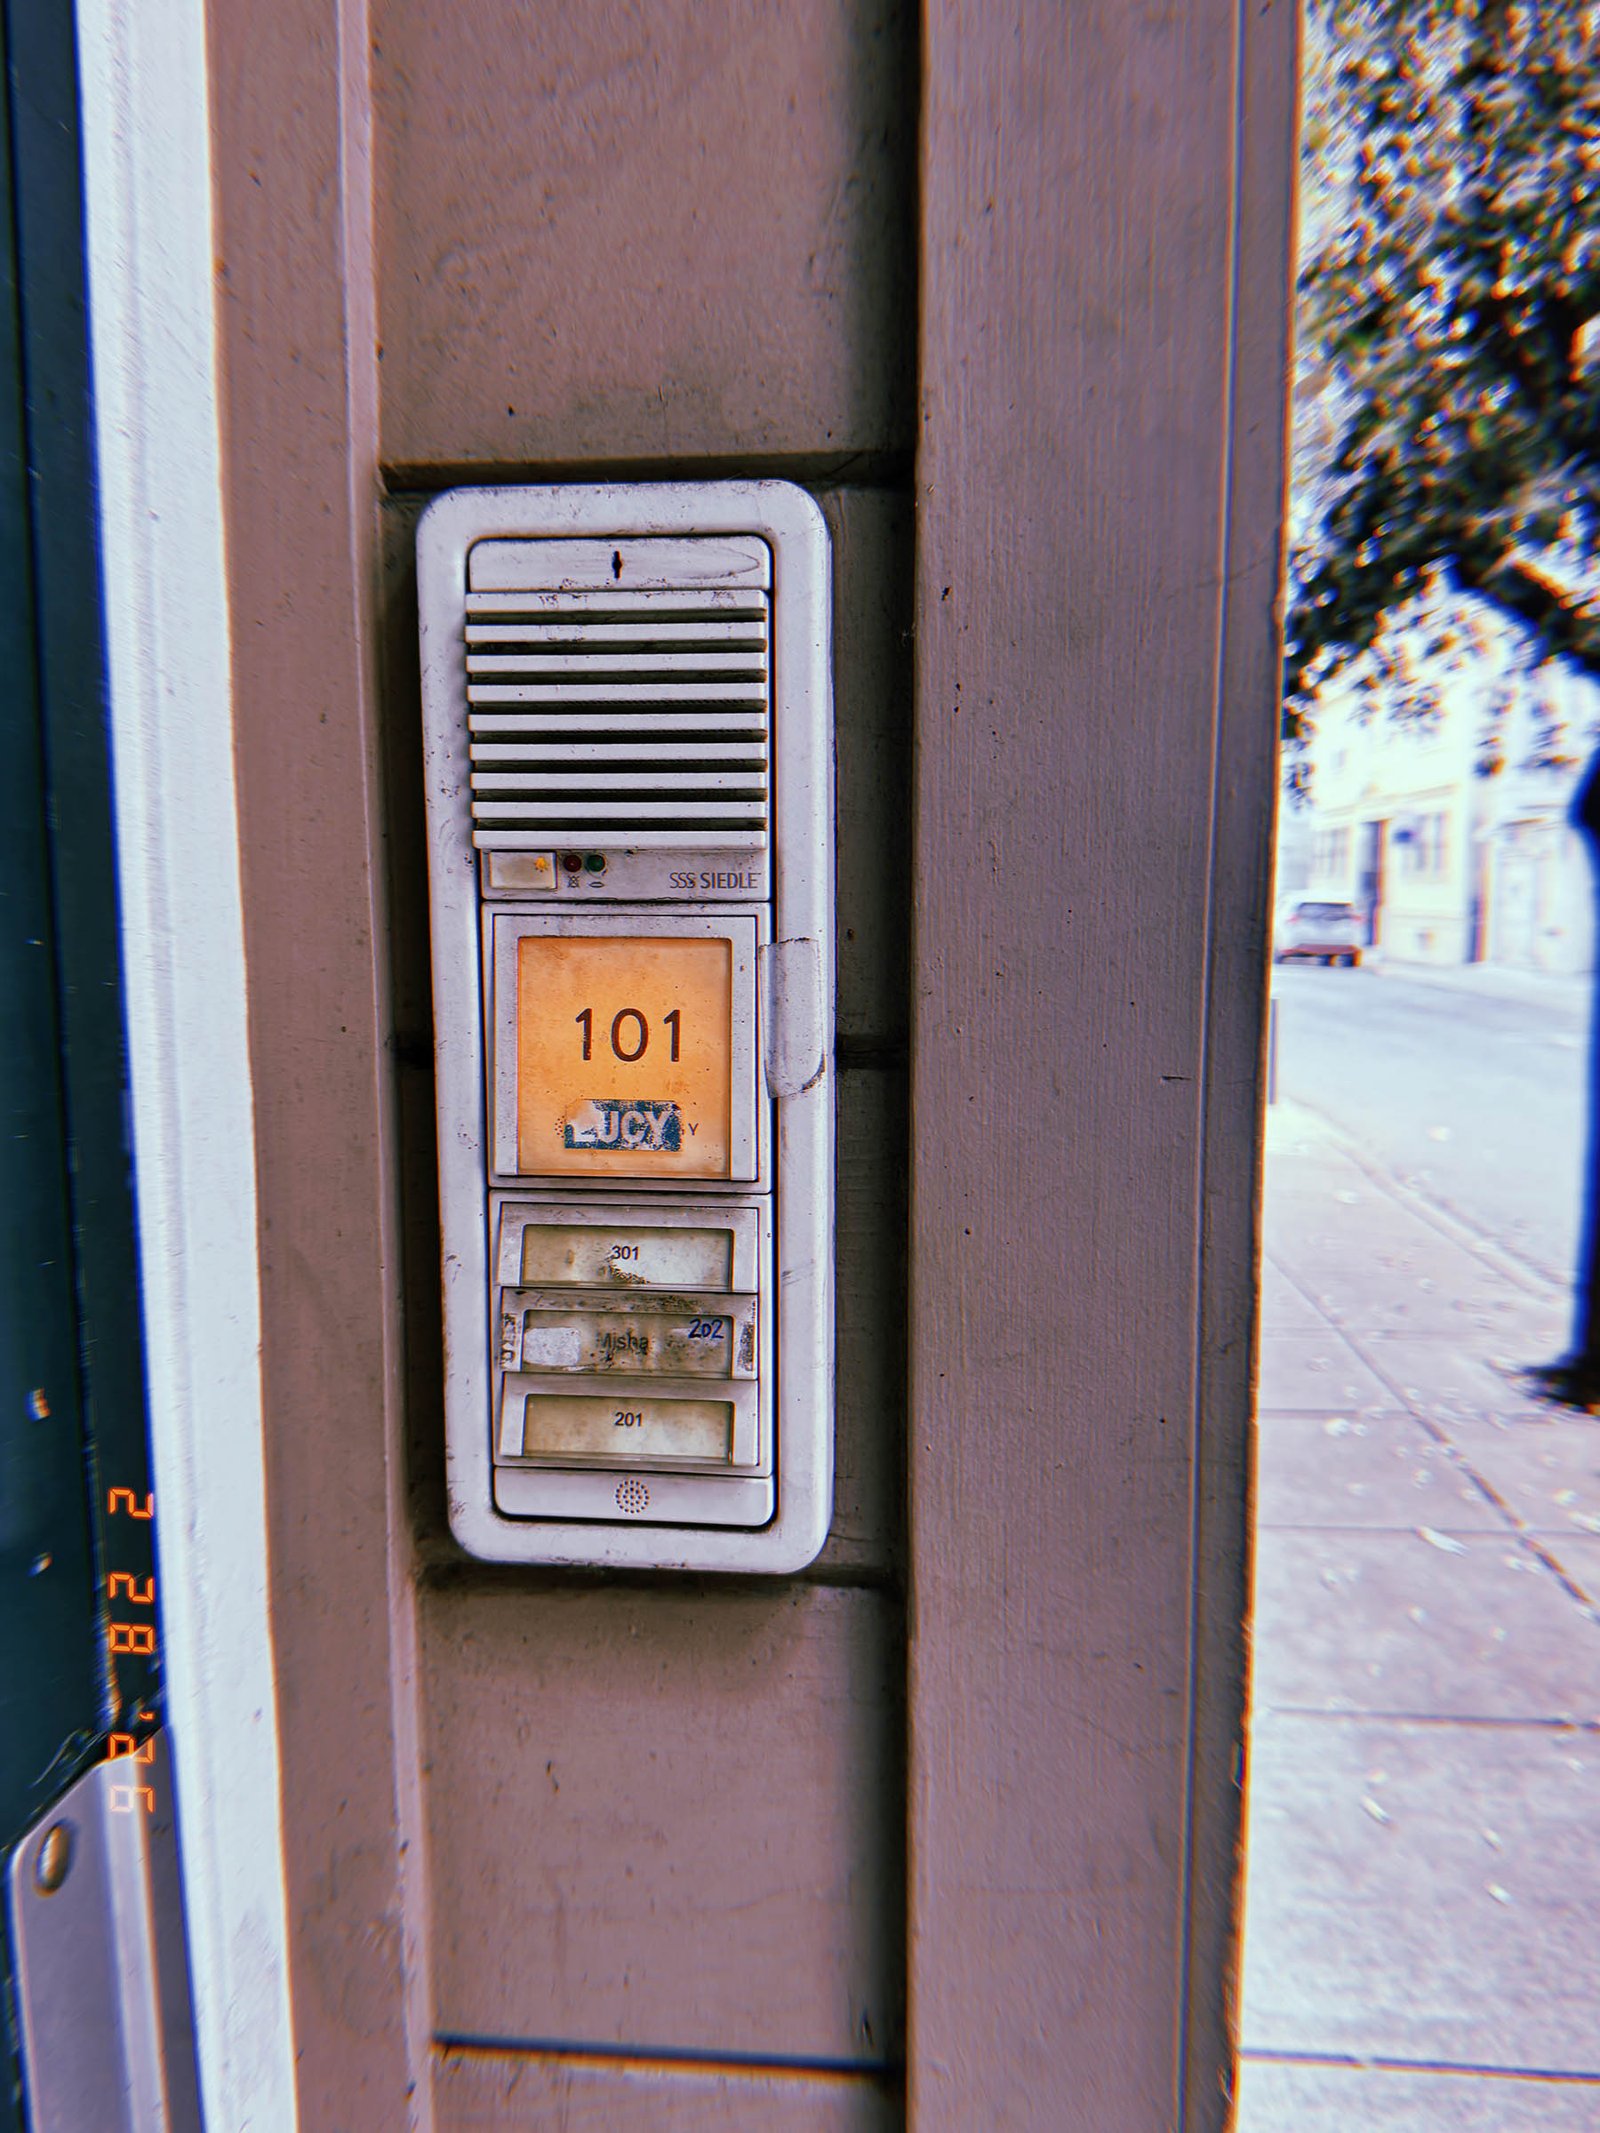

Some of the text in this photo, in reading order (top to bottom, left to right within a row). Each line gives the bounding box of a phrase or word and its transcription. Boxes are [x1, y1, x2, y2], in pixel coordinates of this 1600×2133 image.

[700, 872, 759, 889] SIEDLE
[575, 1008, 681, 1062] 101
[611, 1245, 640, 1261] 301
[687, 1318, 725, 1340] 202
[614, 1411, 644, 1427] 201
